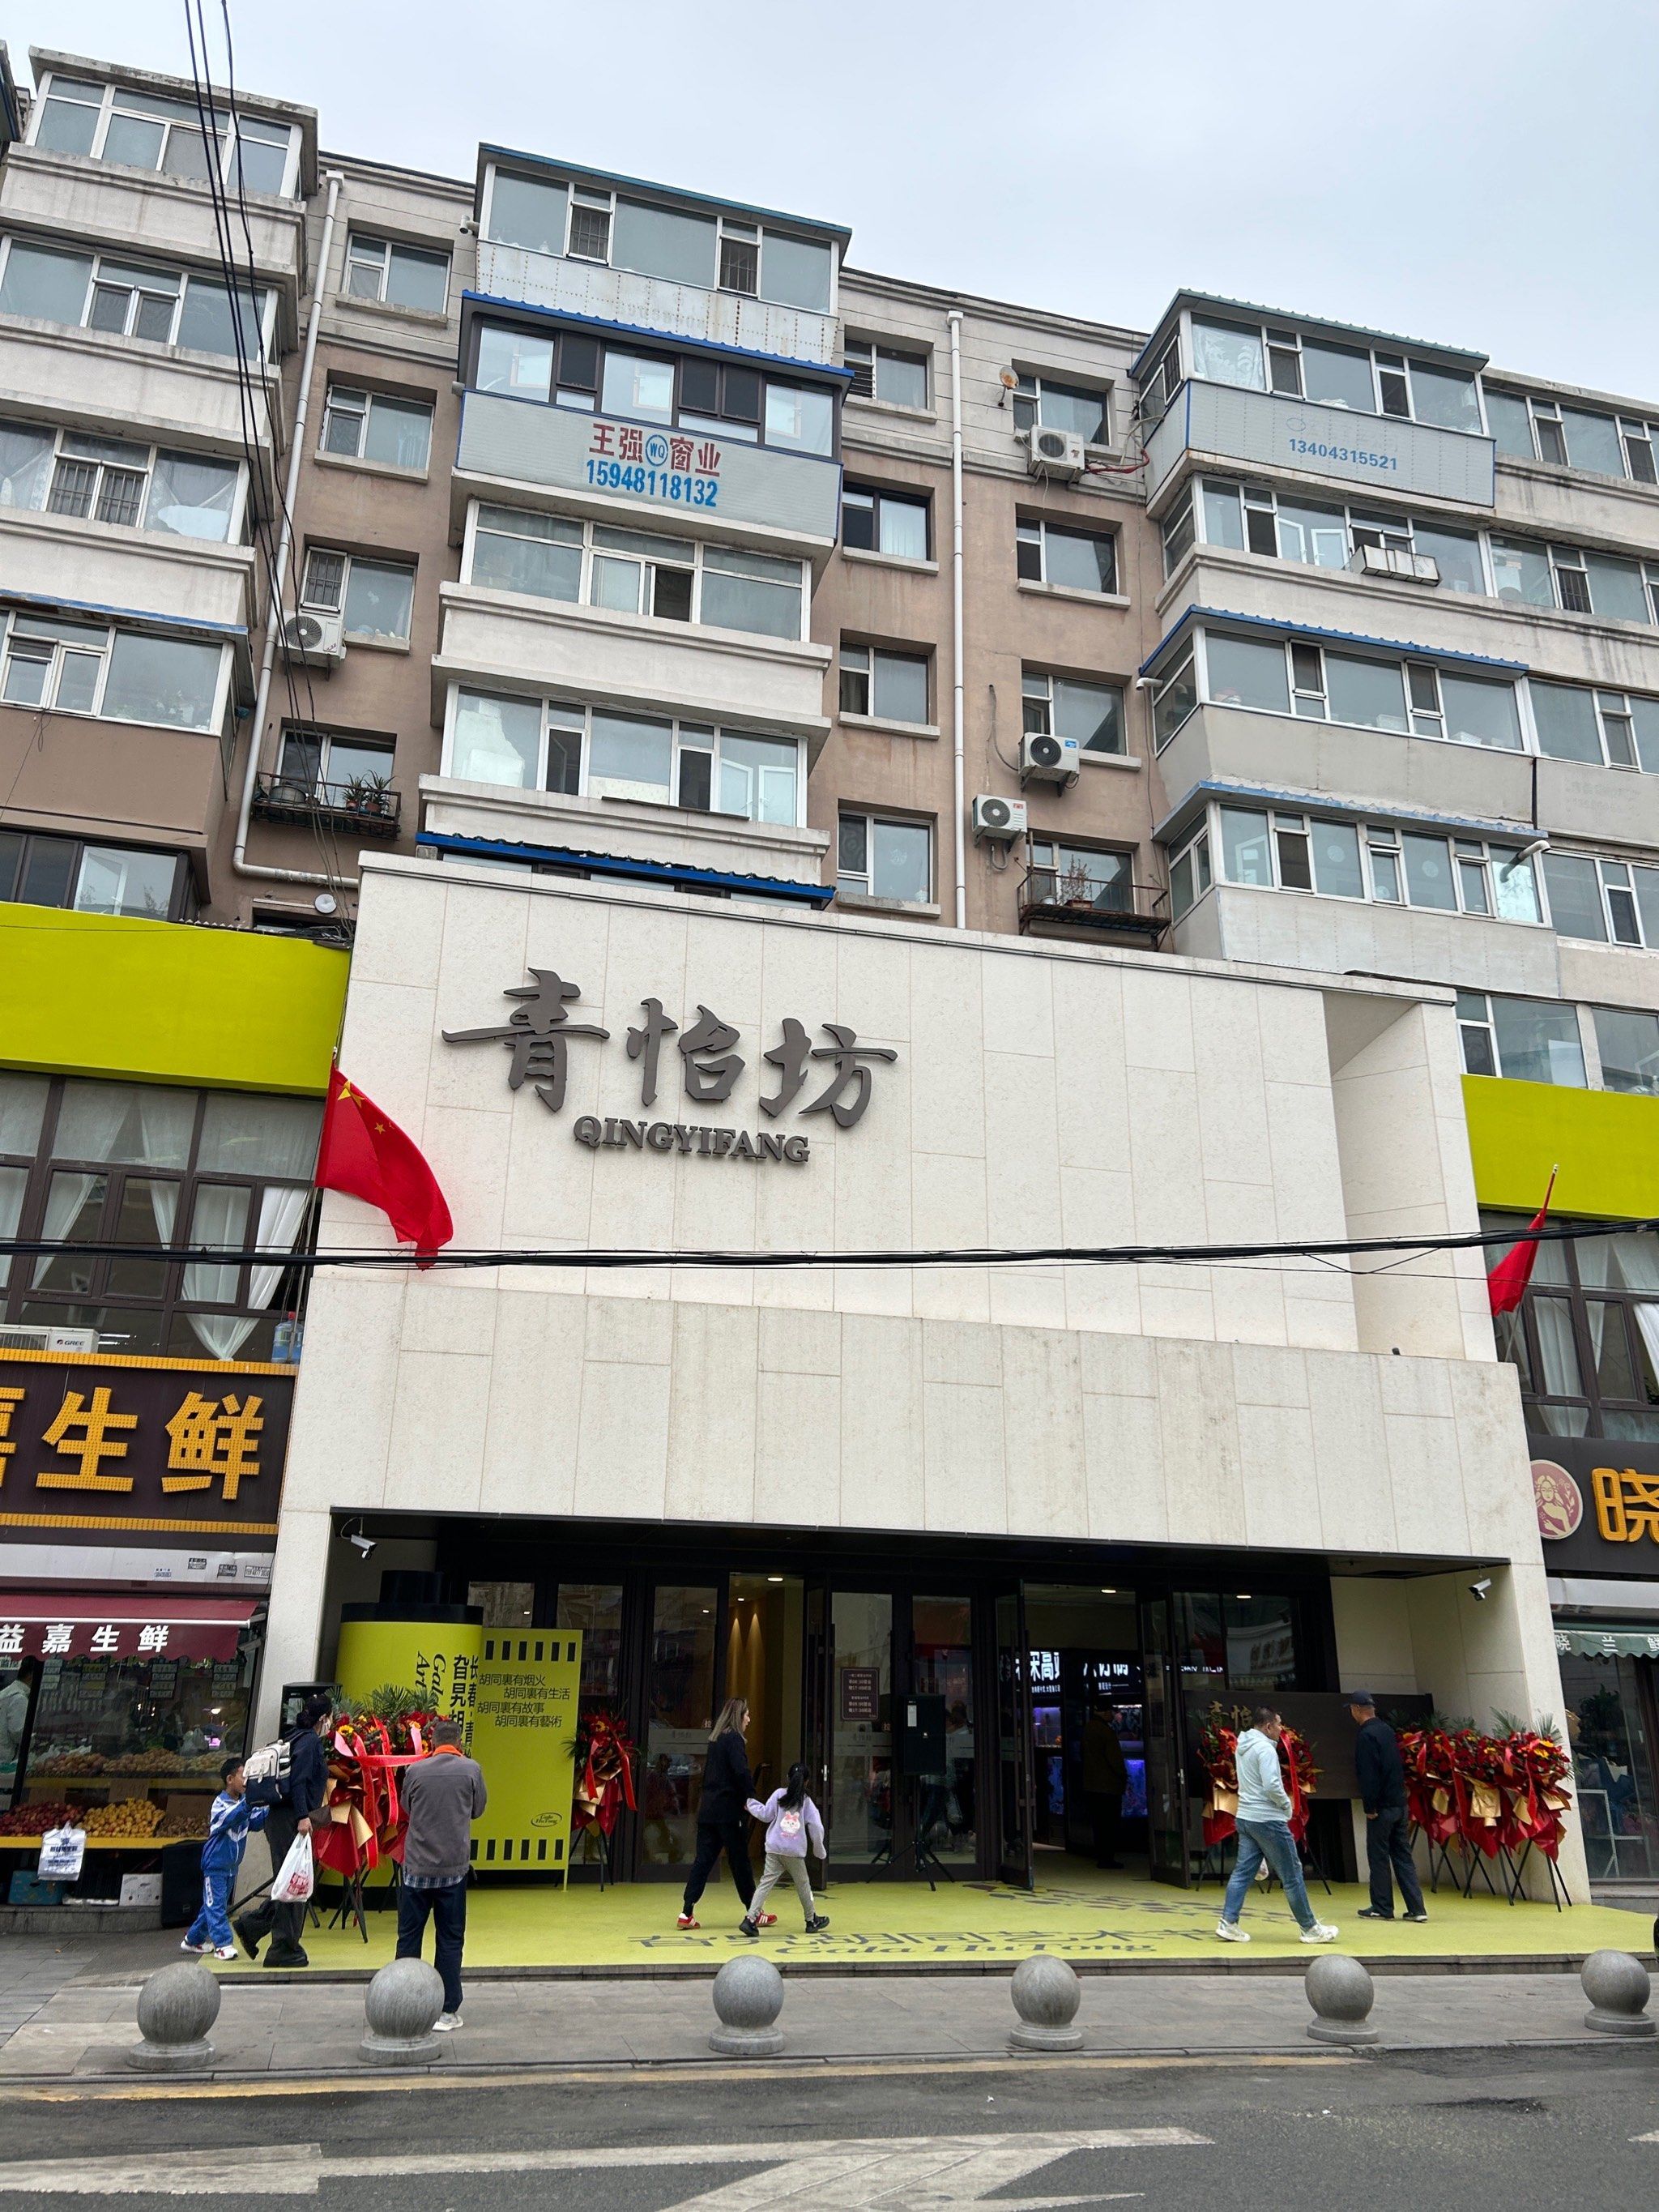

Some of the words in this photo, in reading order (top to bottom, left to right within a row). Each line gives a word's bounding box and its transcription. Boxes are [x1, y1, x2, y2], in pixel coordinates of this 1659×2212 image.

[589, 423, 642, 463] 王强
[1289, 438, 1397, 471] 13404315521
[586, 459, 718, 507] 15948118132
[441, 967, 898, 1127] 青怡坊
[574, 1115, 811, 1164] QINGYIFANG
[0, 1386, 265, 1501] 生鲜
[0, 1623, 169, 1654] 益嘉生鲜
[775, 1945, 913, 1954] Gala
